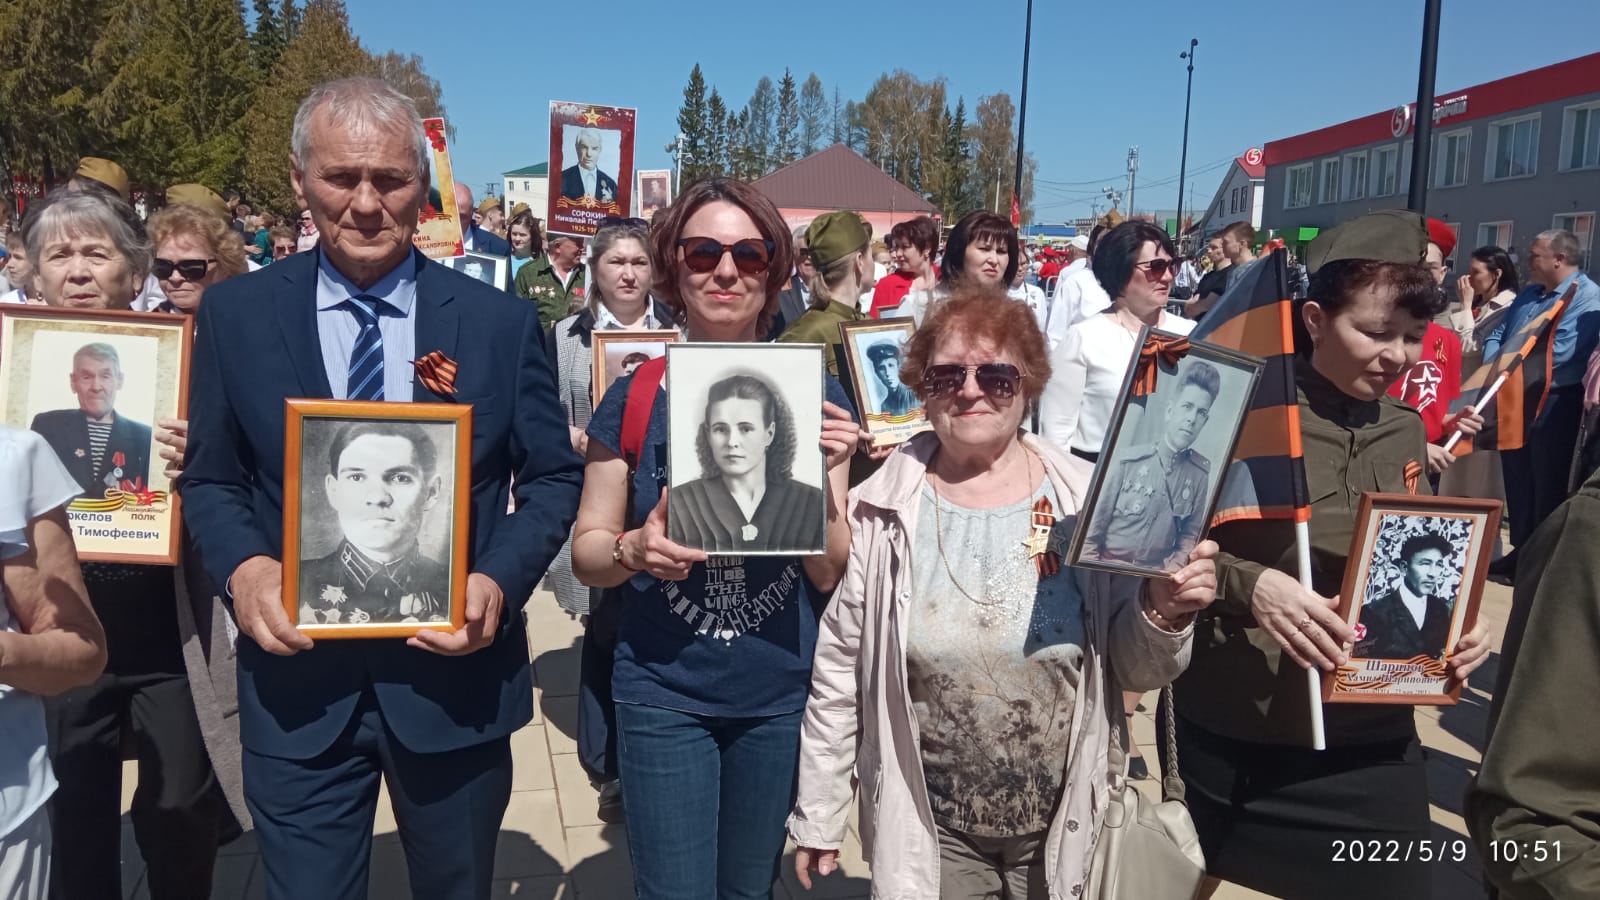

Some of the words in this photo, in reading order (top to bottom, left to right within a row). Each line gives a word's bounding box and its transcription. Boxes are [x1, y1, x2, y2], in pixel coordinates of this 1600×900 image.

[78, 525, 160, 540] Тимофеевич
[705, 582, 746, 596] THE
[704, 593, 747, 610] WINGS
[726, 581, 784, 637] HEART
